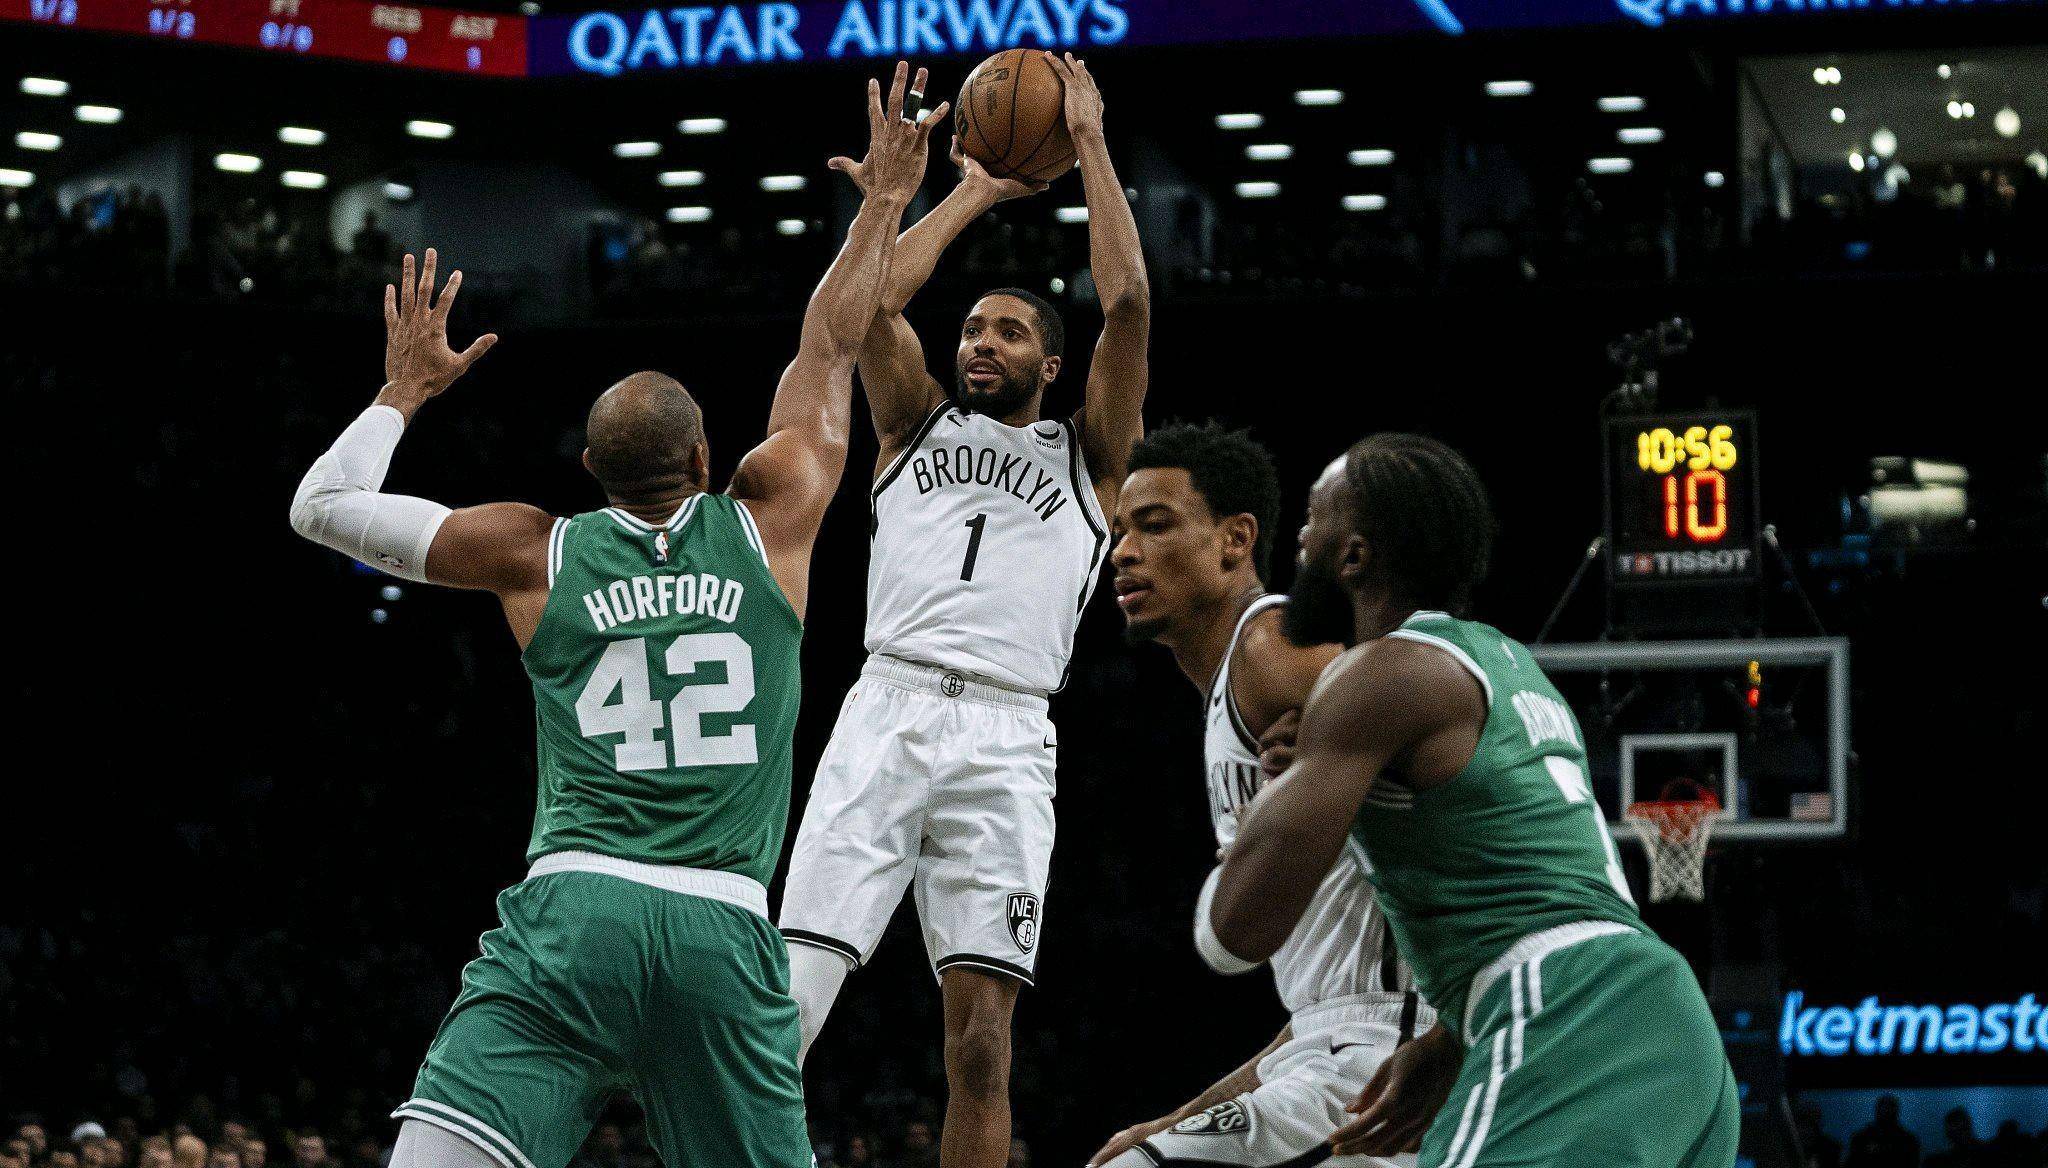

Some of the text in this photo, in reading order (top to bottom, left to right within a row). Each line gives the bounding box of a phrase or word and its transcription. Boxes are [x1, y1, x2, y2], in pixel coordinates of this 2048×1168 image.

[569, 0, 1129, 76] QATAR AIRWAYS
[912, 444, 1067, 522] BROOKLYN
[1638, 425, 1737, 473] 10:56
[1663, 469, 1728, 544] 10
[960, 512, 987, 582] 1
[582, 573, 744, 632] HORFORD
[574, 632, 759, 773] 42
